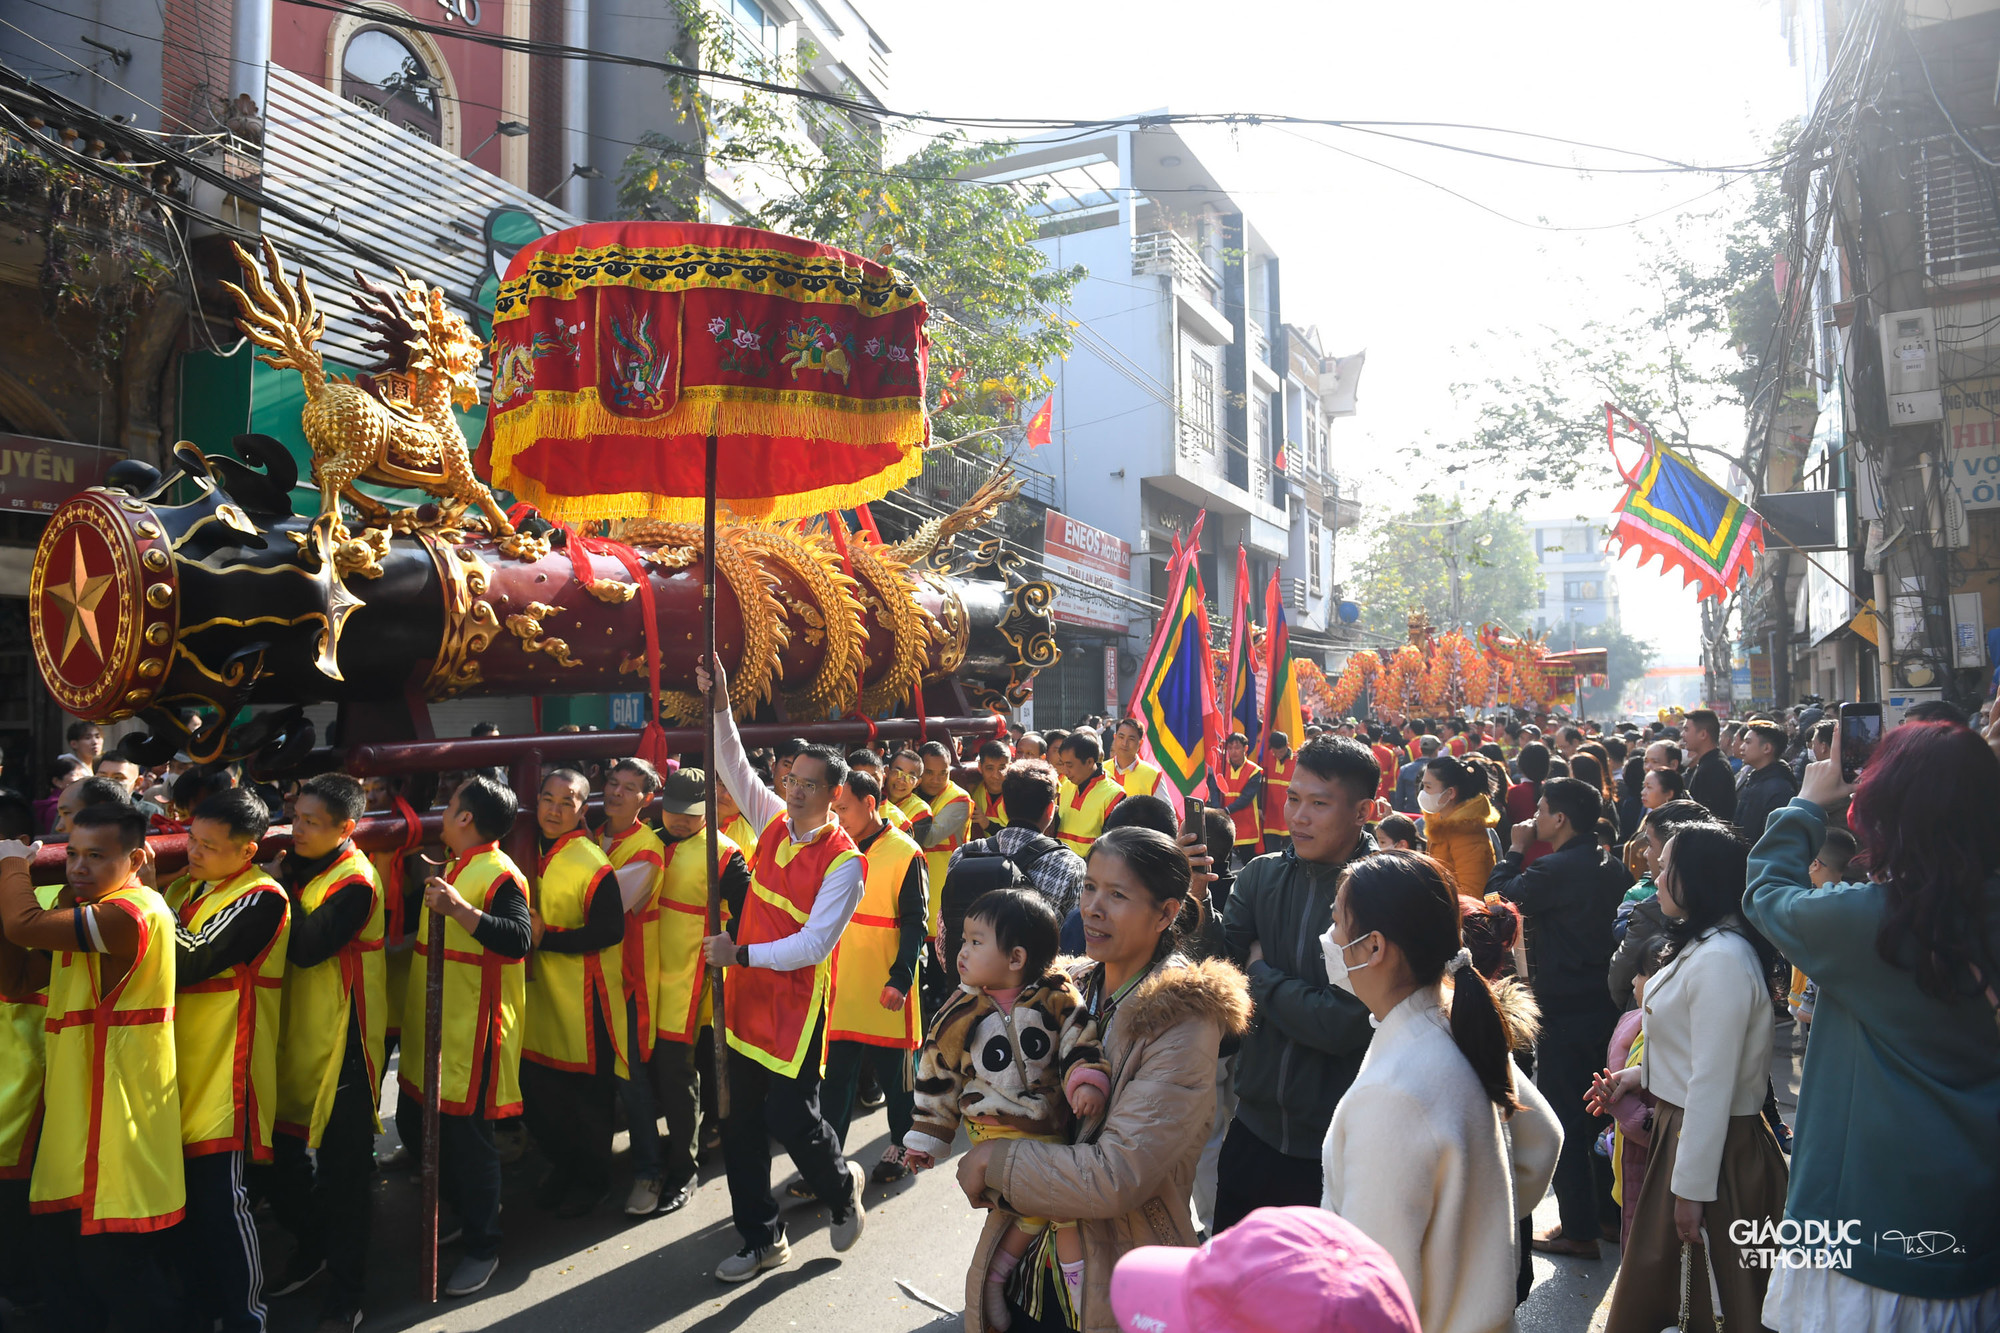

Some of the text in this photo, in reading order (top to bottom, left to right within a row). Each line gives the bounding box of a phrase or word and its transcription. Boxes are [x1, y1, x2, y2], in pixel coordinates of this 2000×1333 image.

[1952, 418, 2000, 449] HI
[1064, 520, 1100, 555] ENEOS
[1100, 543, 1121, 563] MOTOR
